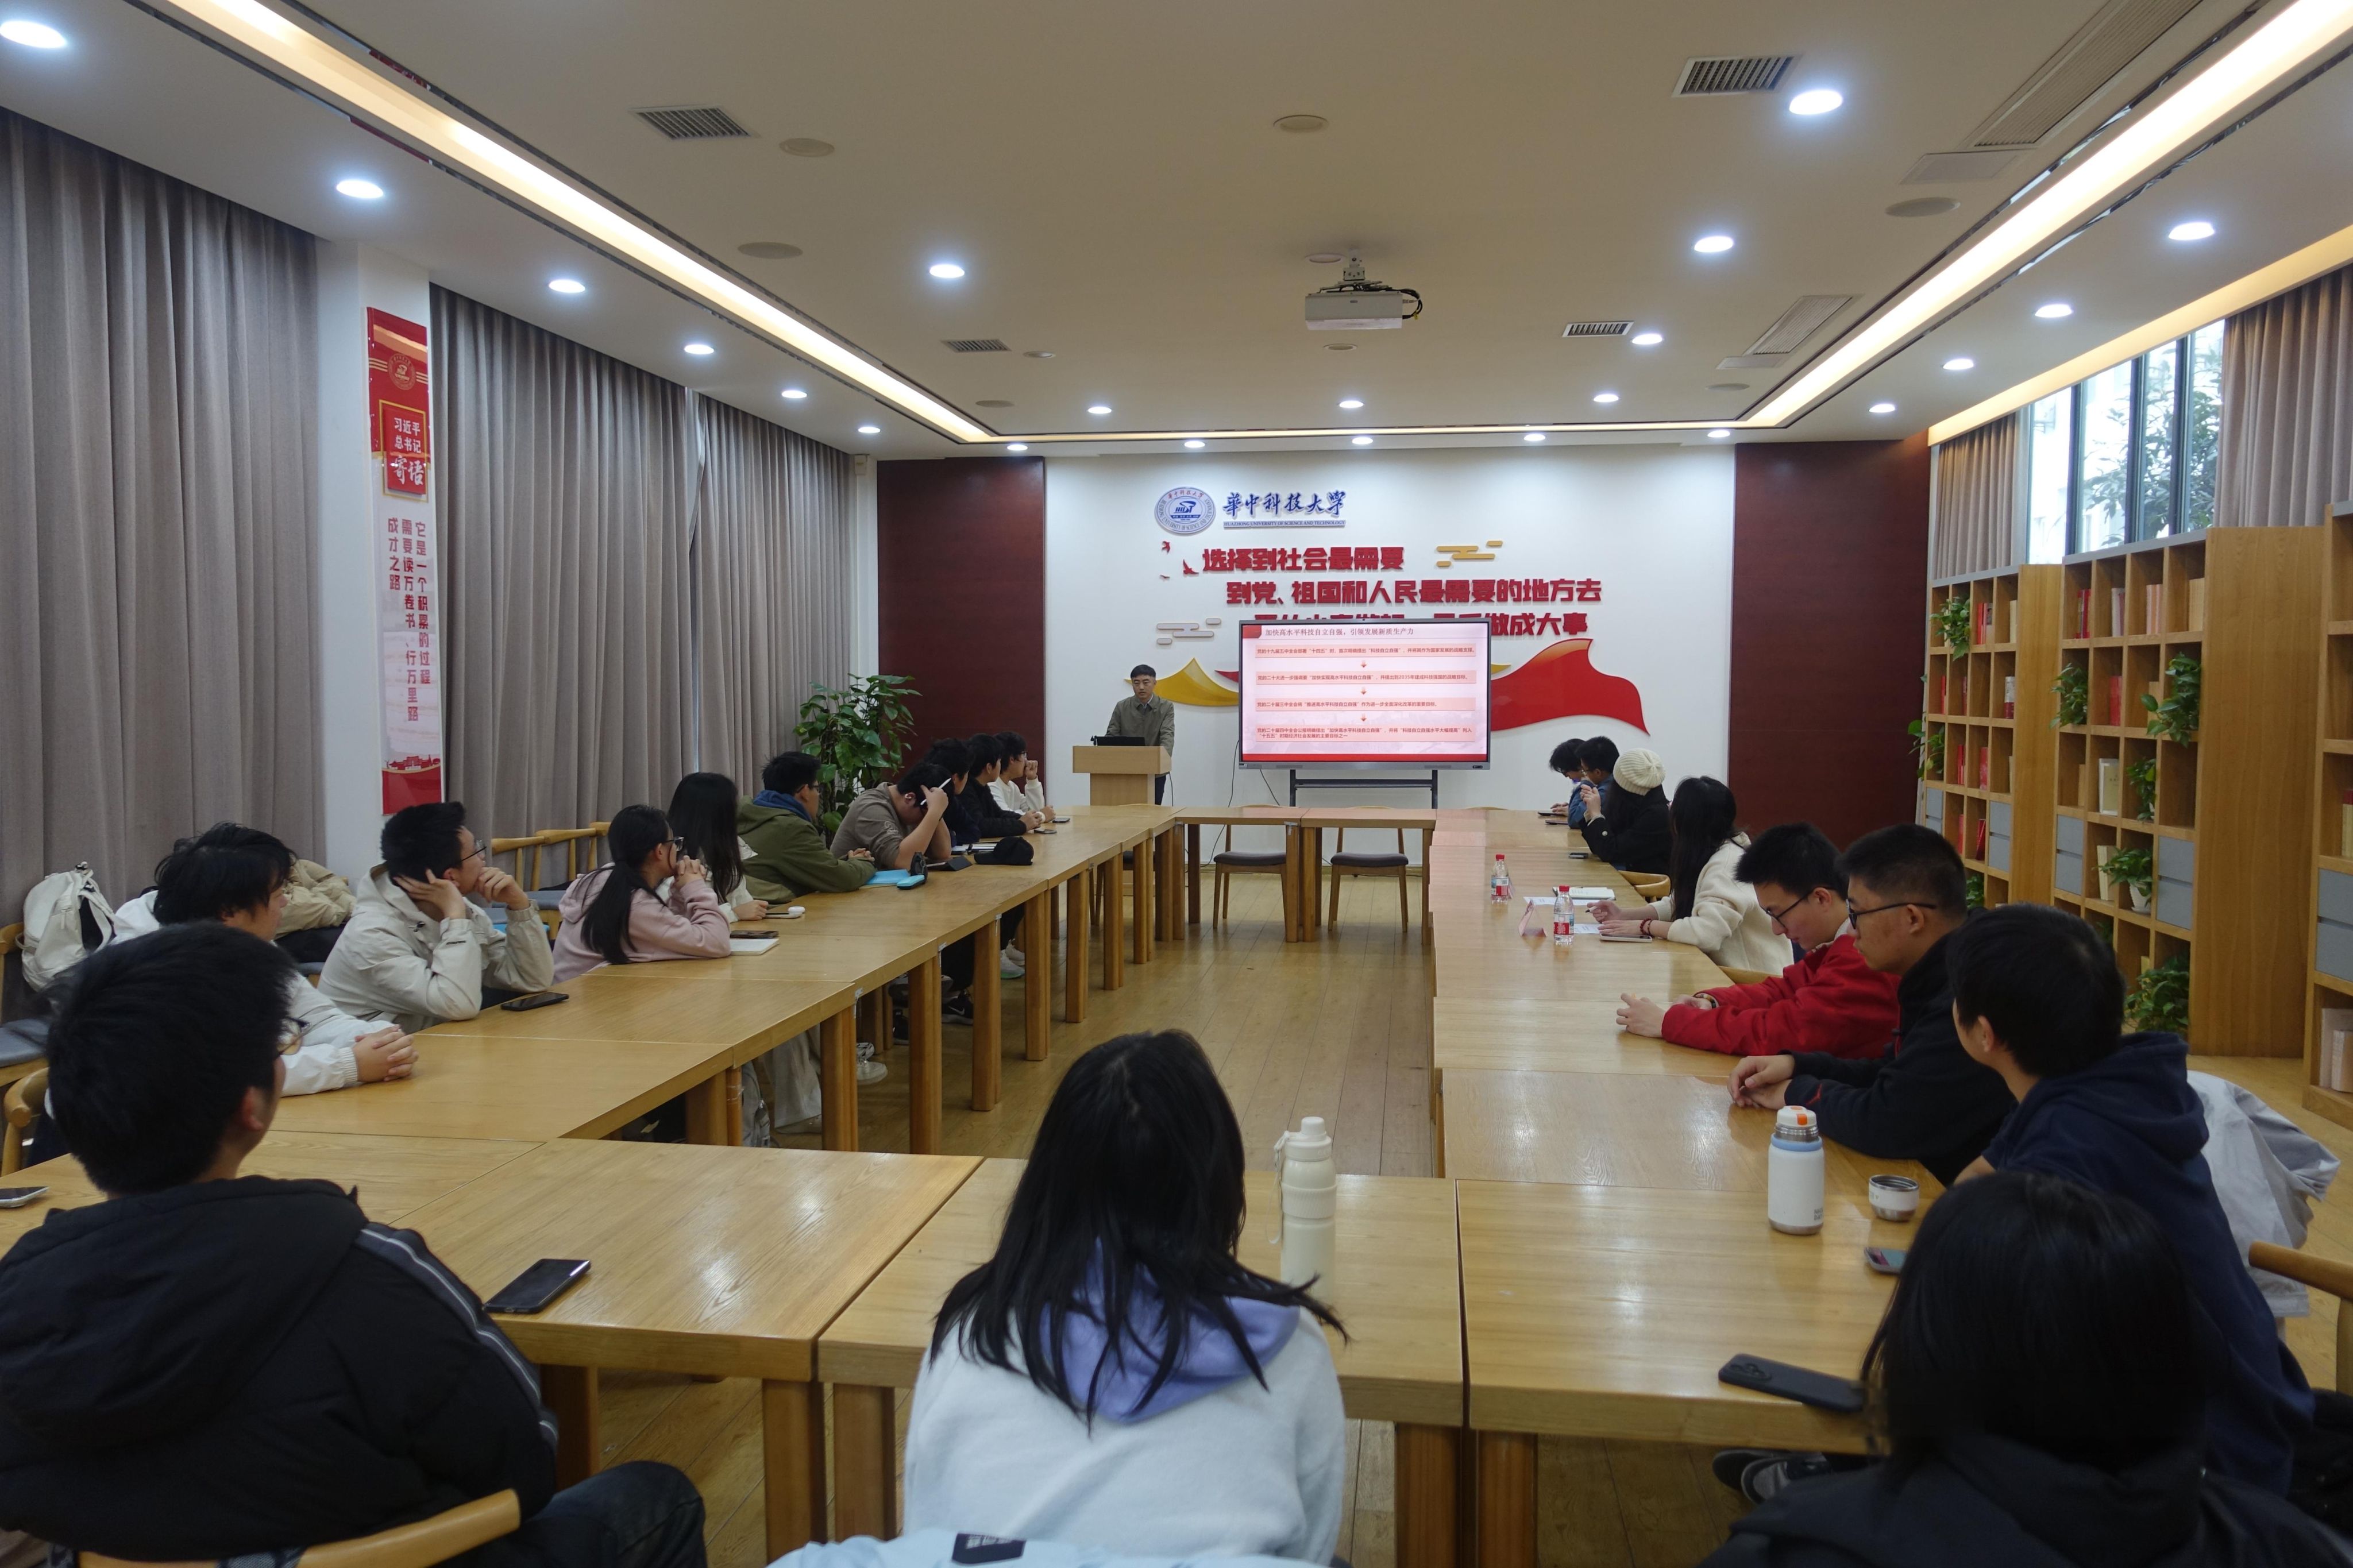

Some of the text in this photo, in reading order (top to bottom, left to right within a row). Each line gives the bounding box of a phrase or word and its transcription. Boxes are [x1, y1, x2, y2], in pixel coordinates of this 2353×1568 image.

[394, 417, 421, 435] 习近平
[394, 435, 422, 454] 总书记
[394, 454, 425, 486] 寄语
[388, 517, 400, 590] 成才之路
[1202, 547, 1403, 571] 选择到社会最需要
[415, 522, 430, 685] 它是一个积累的过程
[1226, 578, 1602, 605] 到党、祖国和人民最需要的地方去
[402, 519, 418, 721] 需要读万卷书、行万里路
